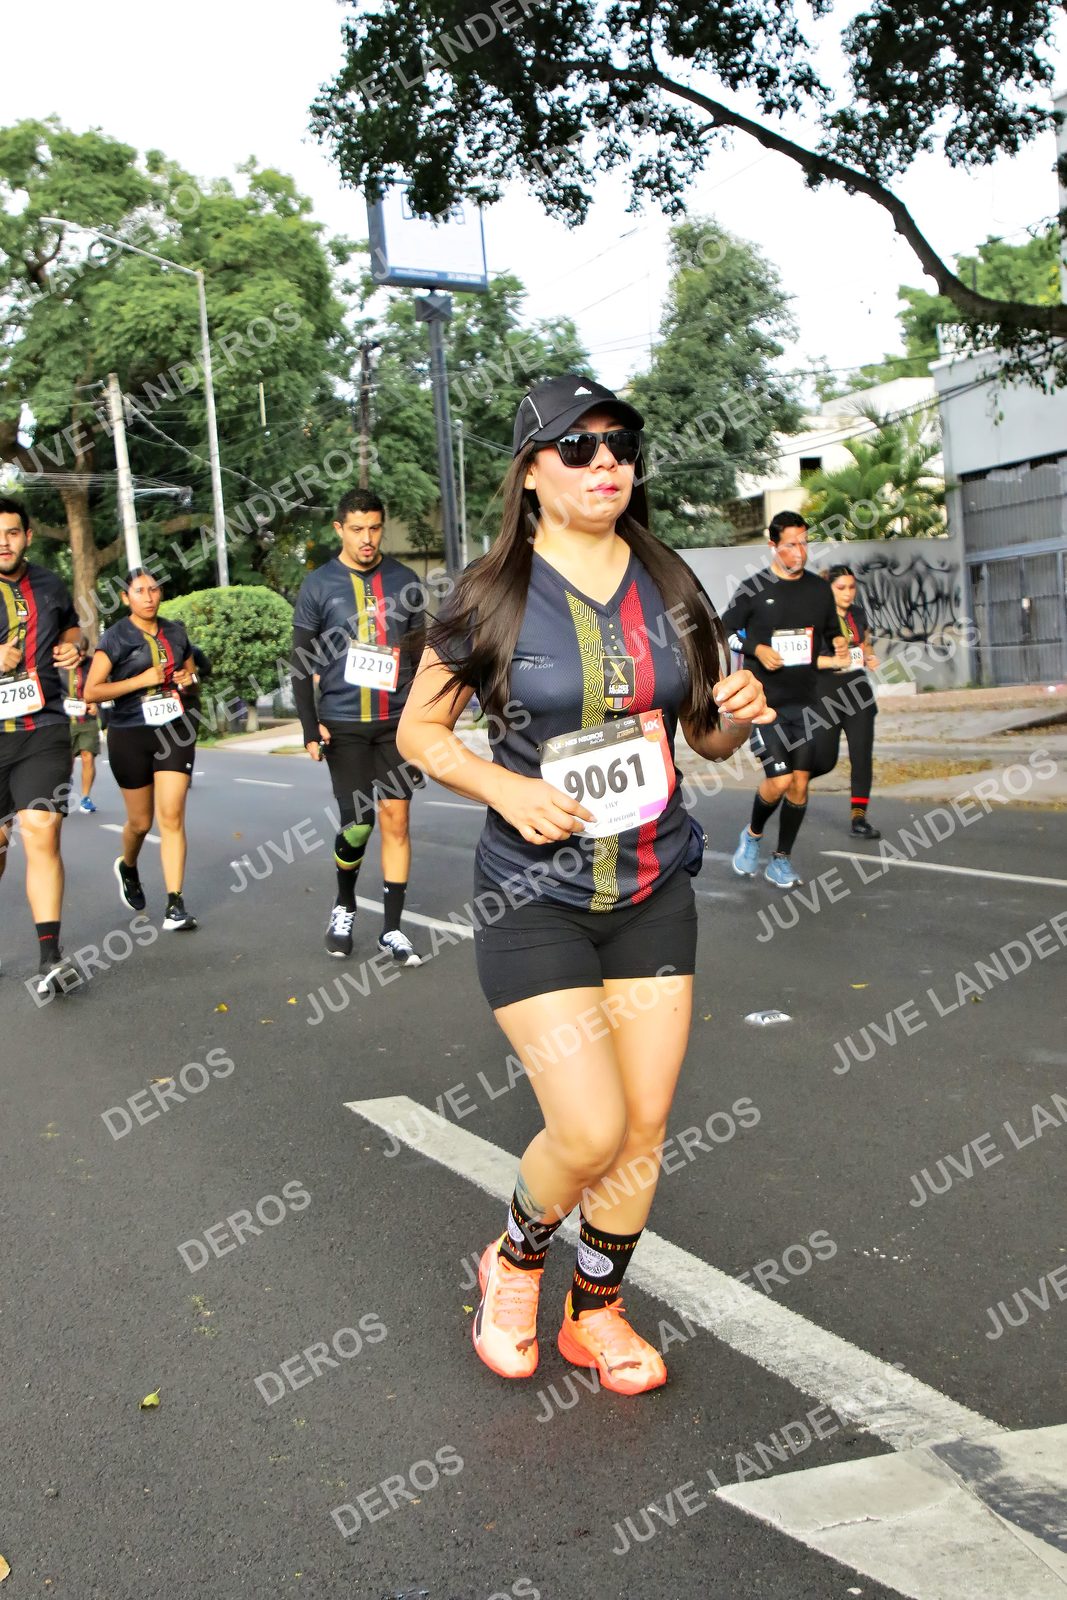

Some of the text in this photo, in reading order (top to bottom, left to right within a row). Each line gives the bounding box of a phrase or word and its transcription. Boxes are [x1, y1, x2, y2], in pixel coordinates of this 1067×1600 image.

[777, 640, 808, 652] 13163
[352, 655, 393, 674] 12219
[147, 702, 178, 717] 12786
[564, 753, 645, 803] 9061
